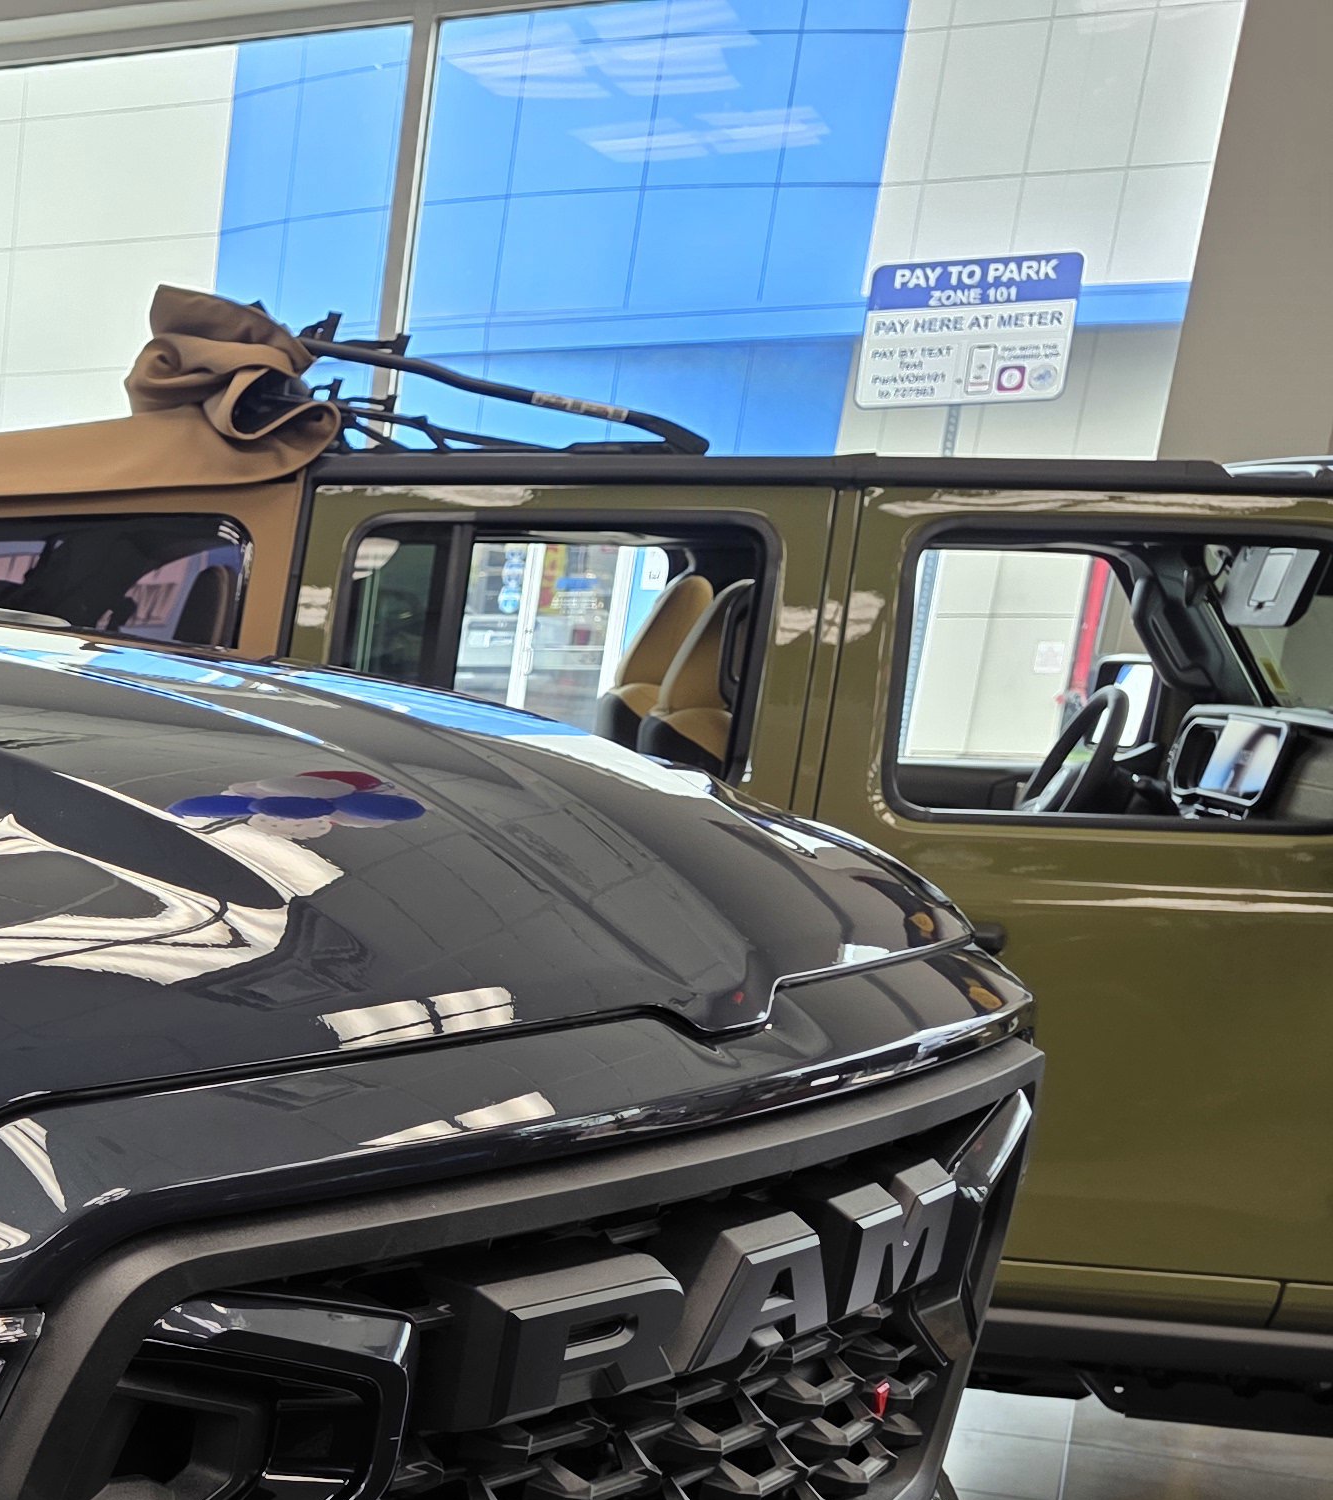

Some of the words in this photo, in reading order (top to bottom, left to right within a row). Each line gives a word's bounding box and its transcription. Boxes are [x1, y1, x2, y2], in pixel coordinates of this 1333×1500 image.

[894, 266, 943, 290] PAY
[948, 264, 982, 286] TO
[987, 258, 1060, 283] PARK
[928, 287, 982, 307] ZONE
[987, 285, 1018, 304] 101
[874, 319, 909, 336] PAY
[913, 316, 964, 333] HERE
[968, 314, 992, 330] AT
[996, 310, 1064, 328] METER
[871, 348, 895, 360] PAY
[898, 347, 916, 359] BY
[921, 345, 953, 358] TEXT
[473, 1160, 958, 1428] RAM
